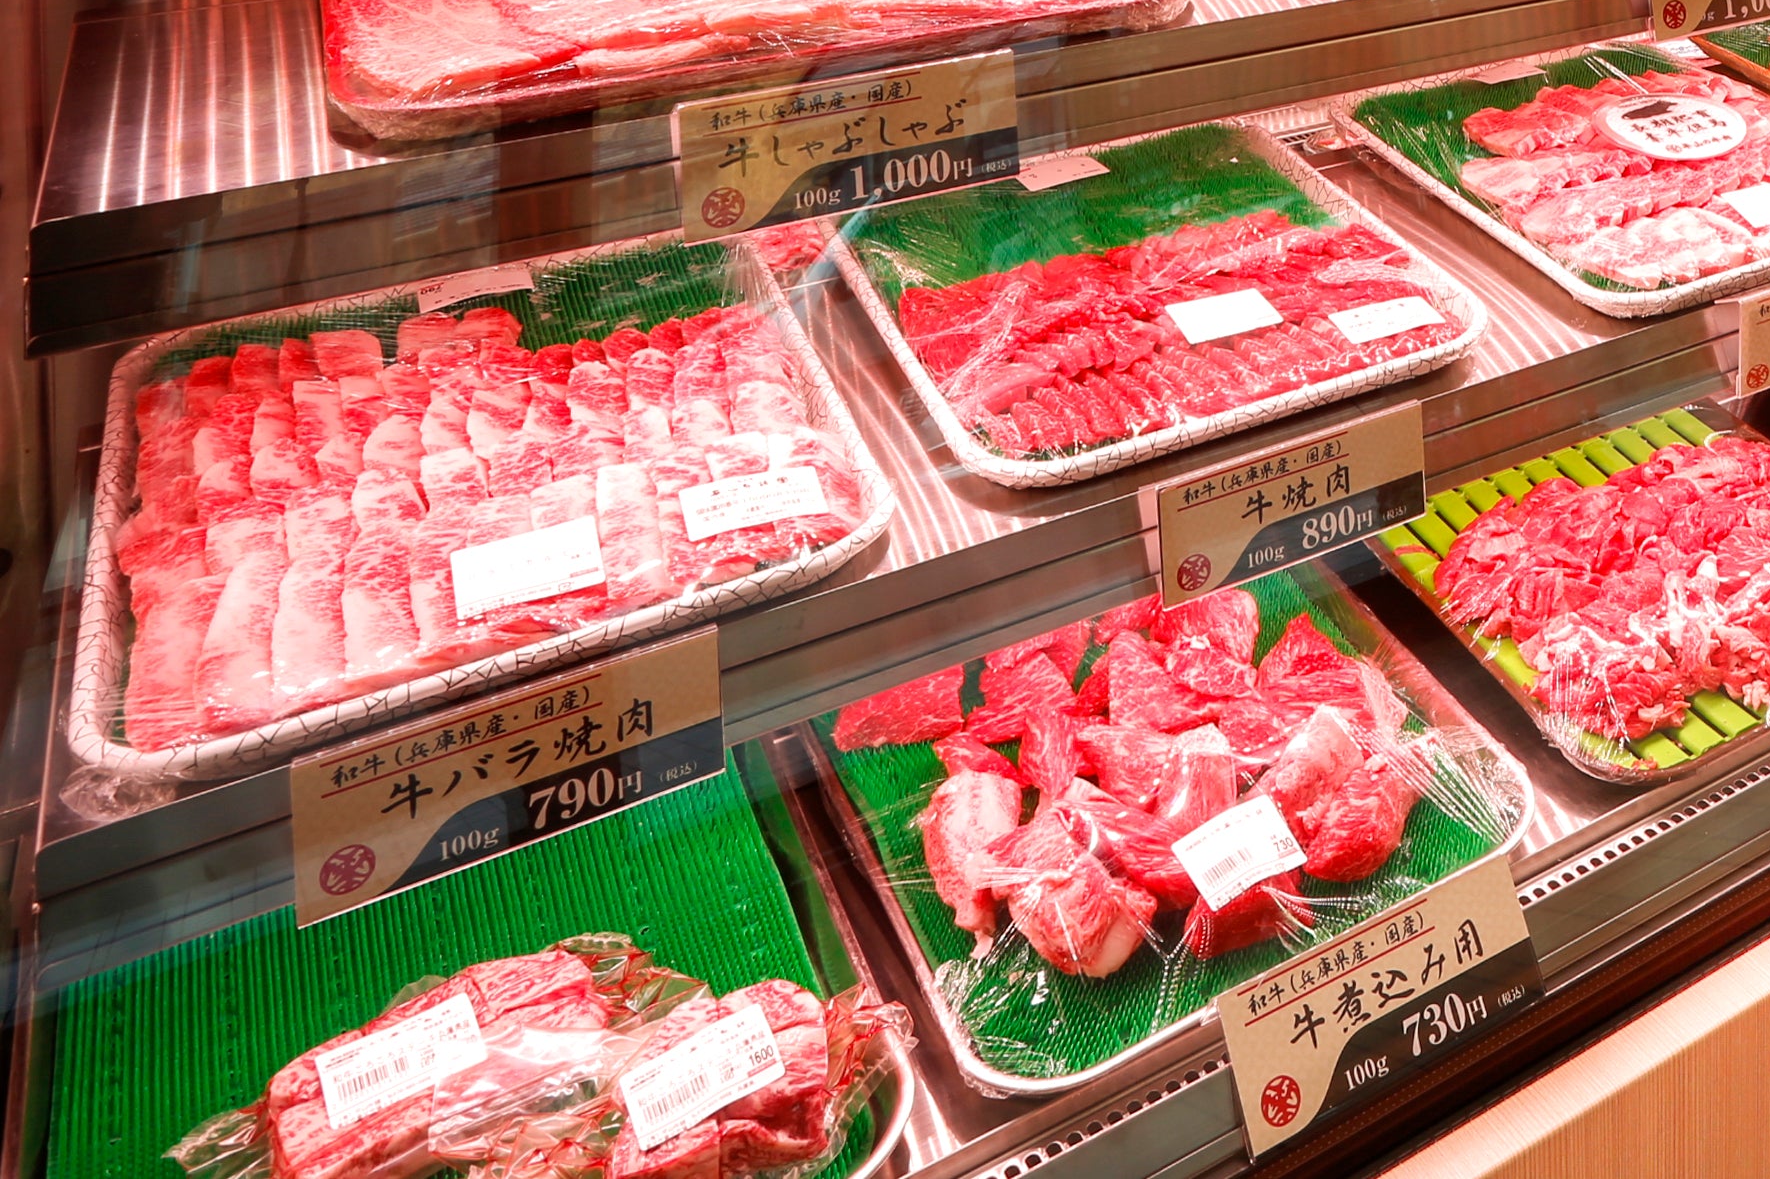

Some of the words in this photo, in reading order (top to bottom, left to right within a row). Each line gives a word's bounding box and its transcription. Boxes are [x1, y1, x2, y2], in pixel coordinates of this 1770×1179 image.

[718, 99, 967, 177] 牛しゃぶしゃぶ
[794, 187, 841, 210] 100g
[851, 149, 973, 201] 1,000円
[1241, 464, 1351, 525] 牛焼肉
[1247, 545, 1285, 568] 100g
[1302, 505, 1373, 550] 890円
[380, 699, 653, 820] 牛バラ焼肉
[439, 827, 500, 862] 100g
[529, 767, 643, 831] 790円
[1273, 837, 1294, 853] 730
[1290, 918, 1484, 1050] 牛煮込み用
[747, 1044, 775, 1066] 1600
[1344, 1055, 1389, 1091] 100g
[1402, 993, 1488, 1057] 730円
